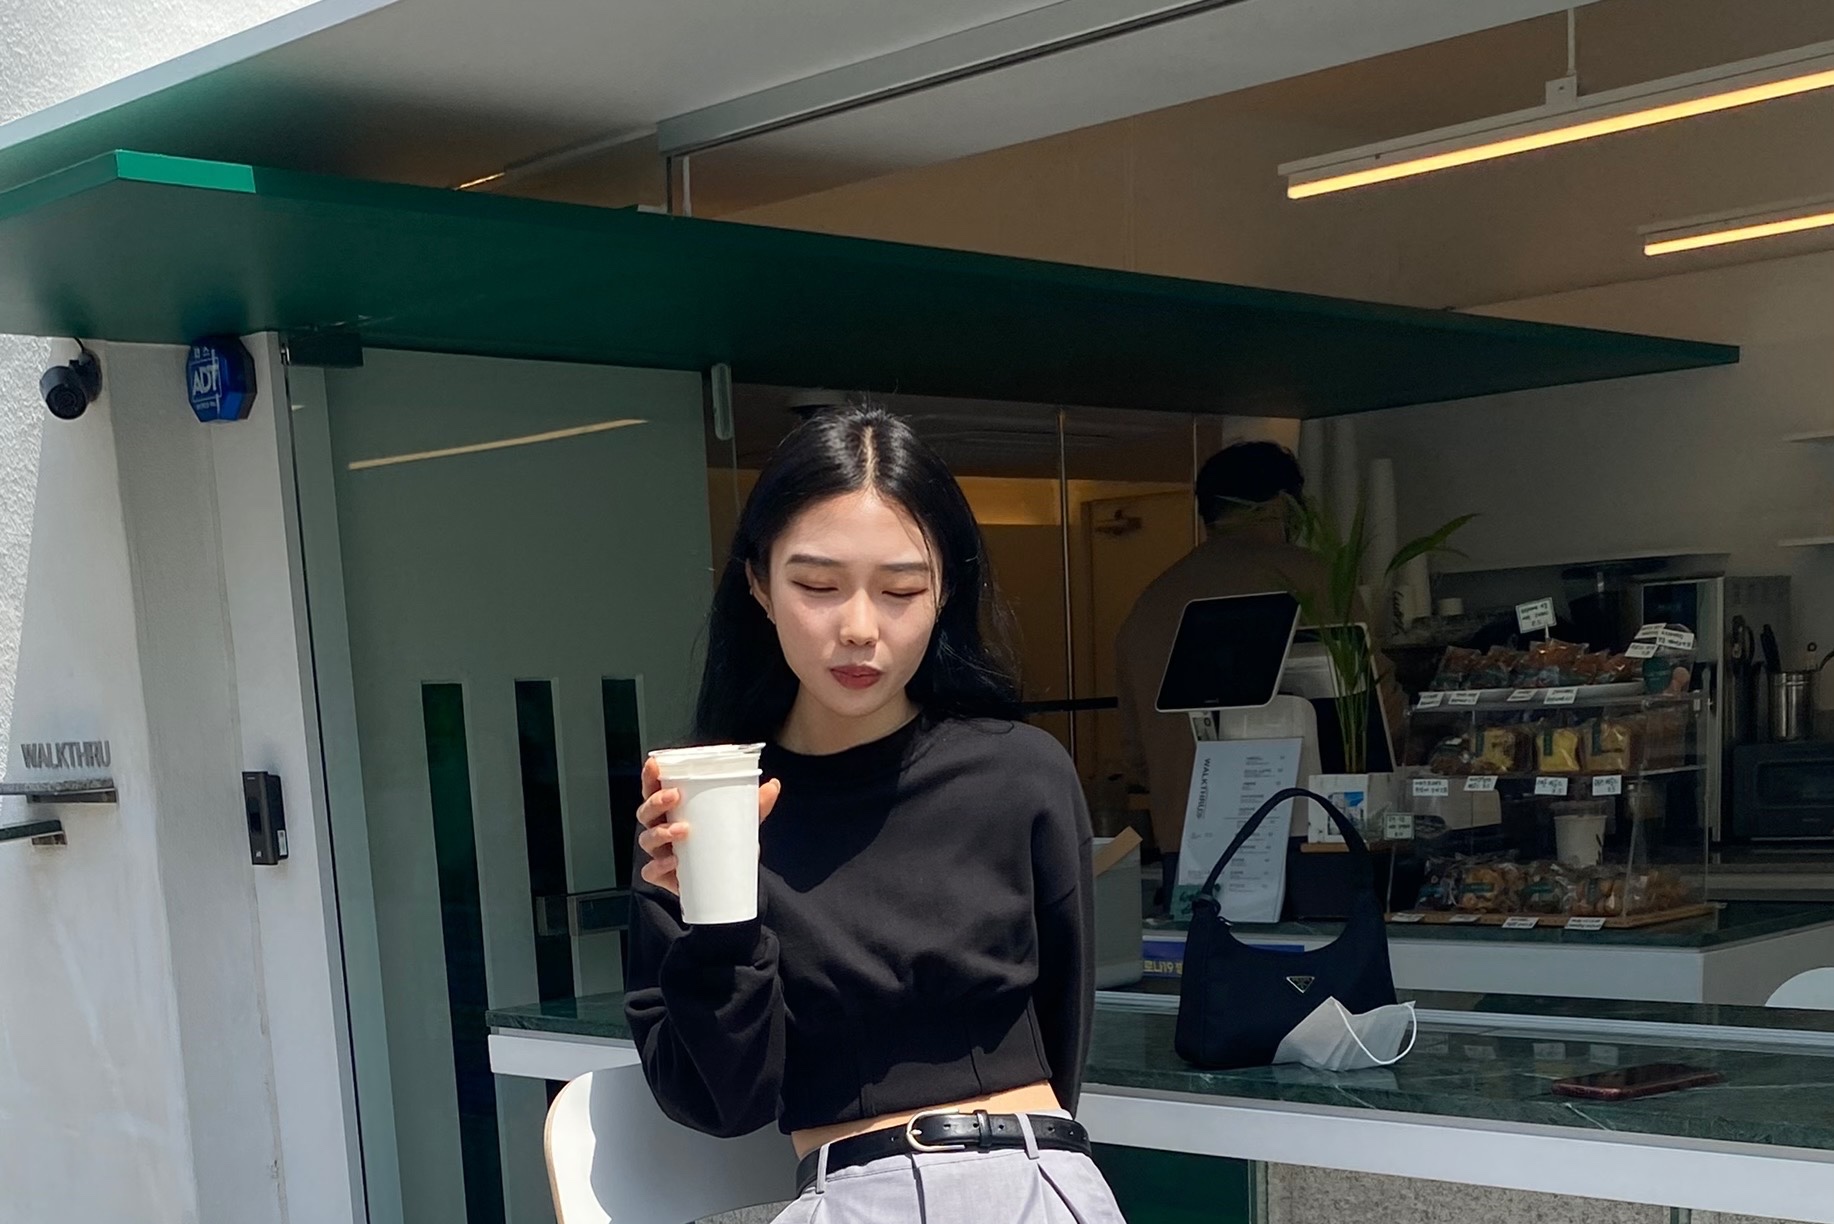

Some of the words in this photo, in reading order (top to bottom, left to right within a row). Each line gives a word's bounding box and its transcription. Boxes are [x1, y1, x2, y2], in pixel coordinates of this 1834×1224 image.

[192, 364, 220, 395] ADT
[20, 740, 111, 769] WALKTHRU
[1143, 960, 1174, 973] 로나19
